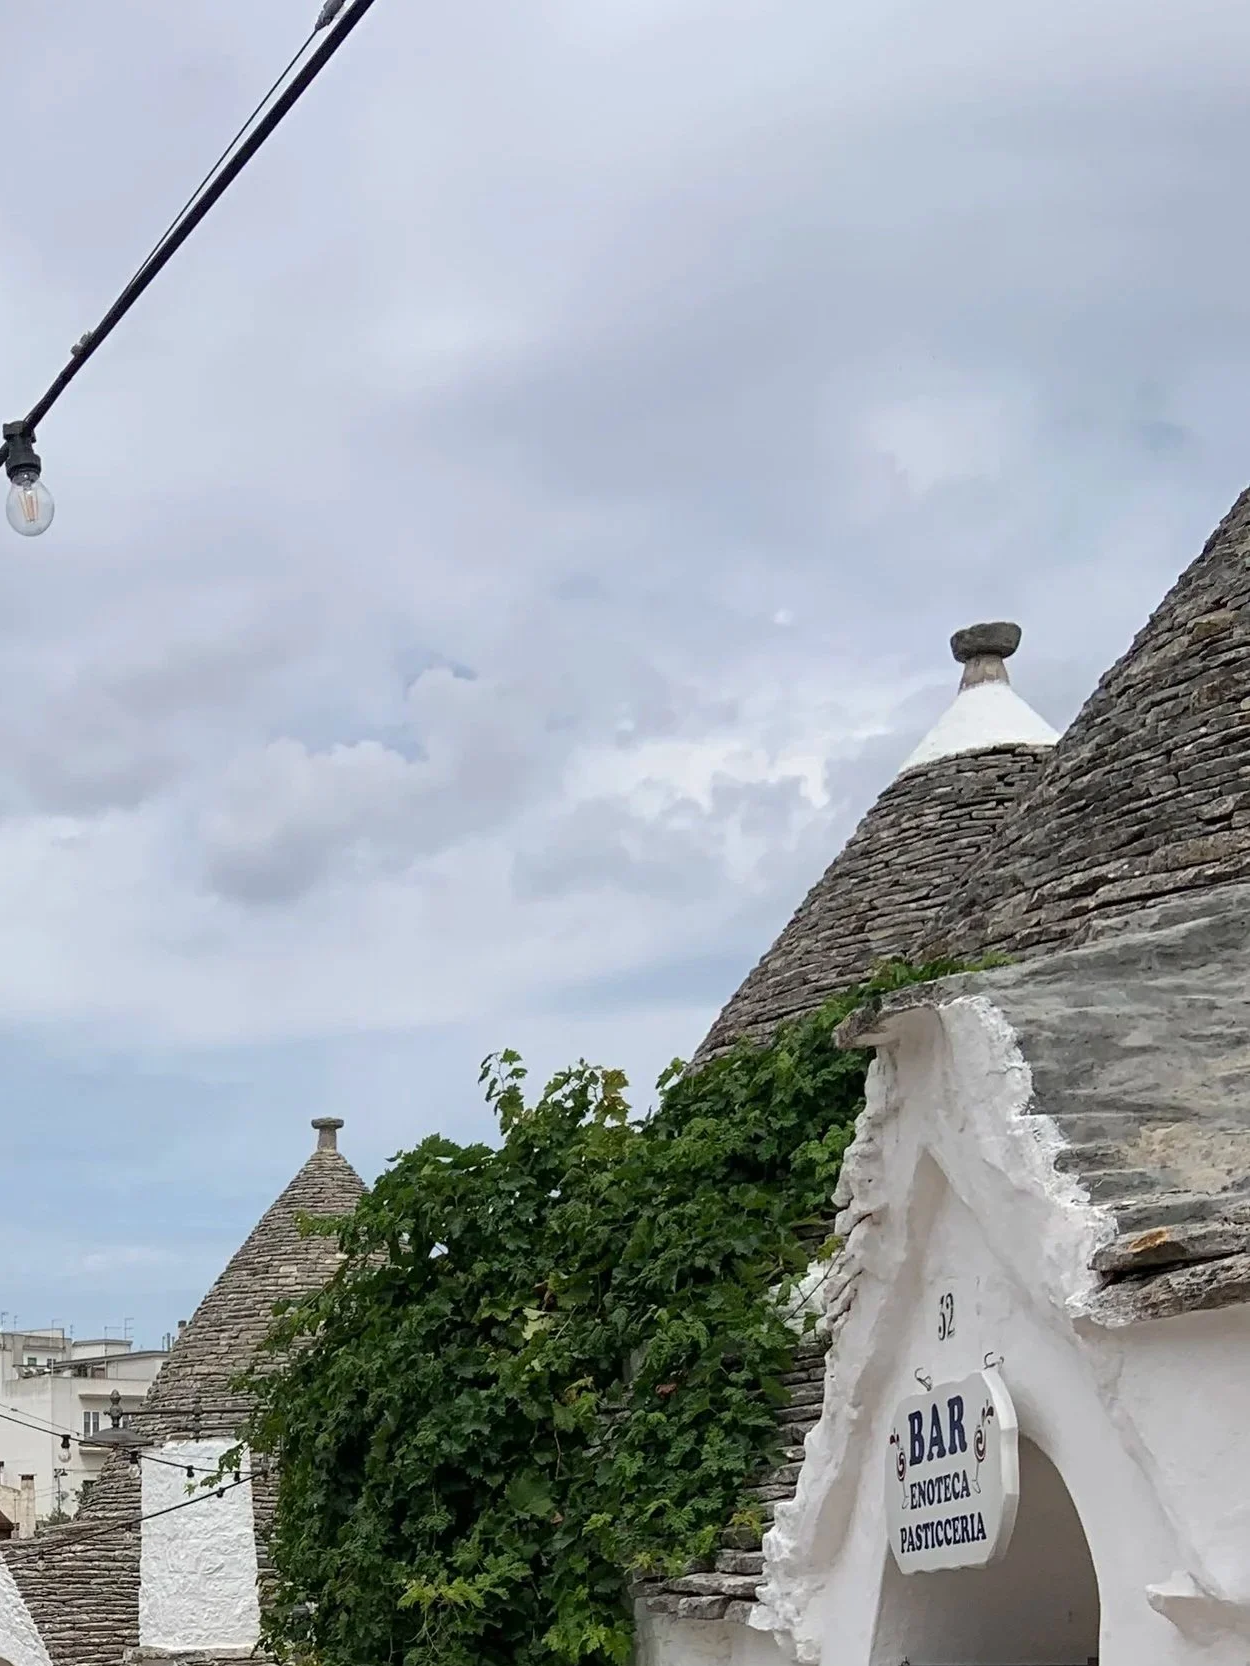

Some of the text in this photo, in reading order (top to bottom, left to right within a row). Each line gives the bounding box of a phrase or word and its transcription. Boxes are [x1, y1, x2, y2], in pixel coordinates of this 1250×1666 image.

[908, 1395, 968, 1466] BAR
[910, 1469, 971, 1510] ENOTECA
[900, 1511, 987, 1554] PASTICCERIA
